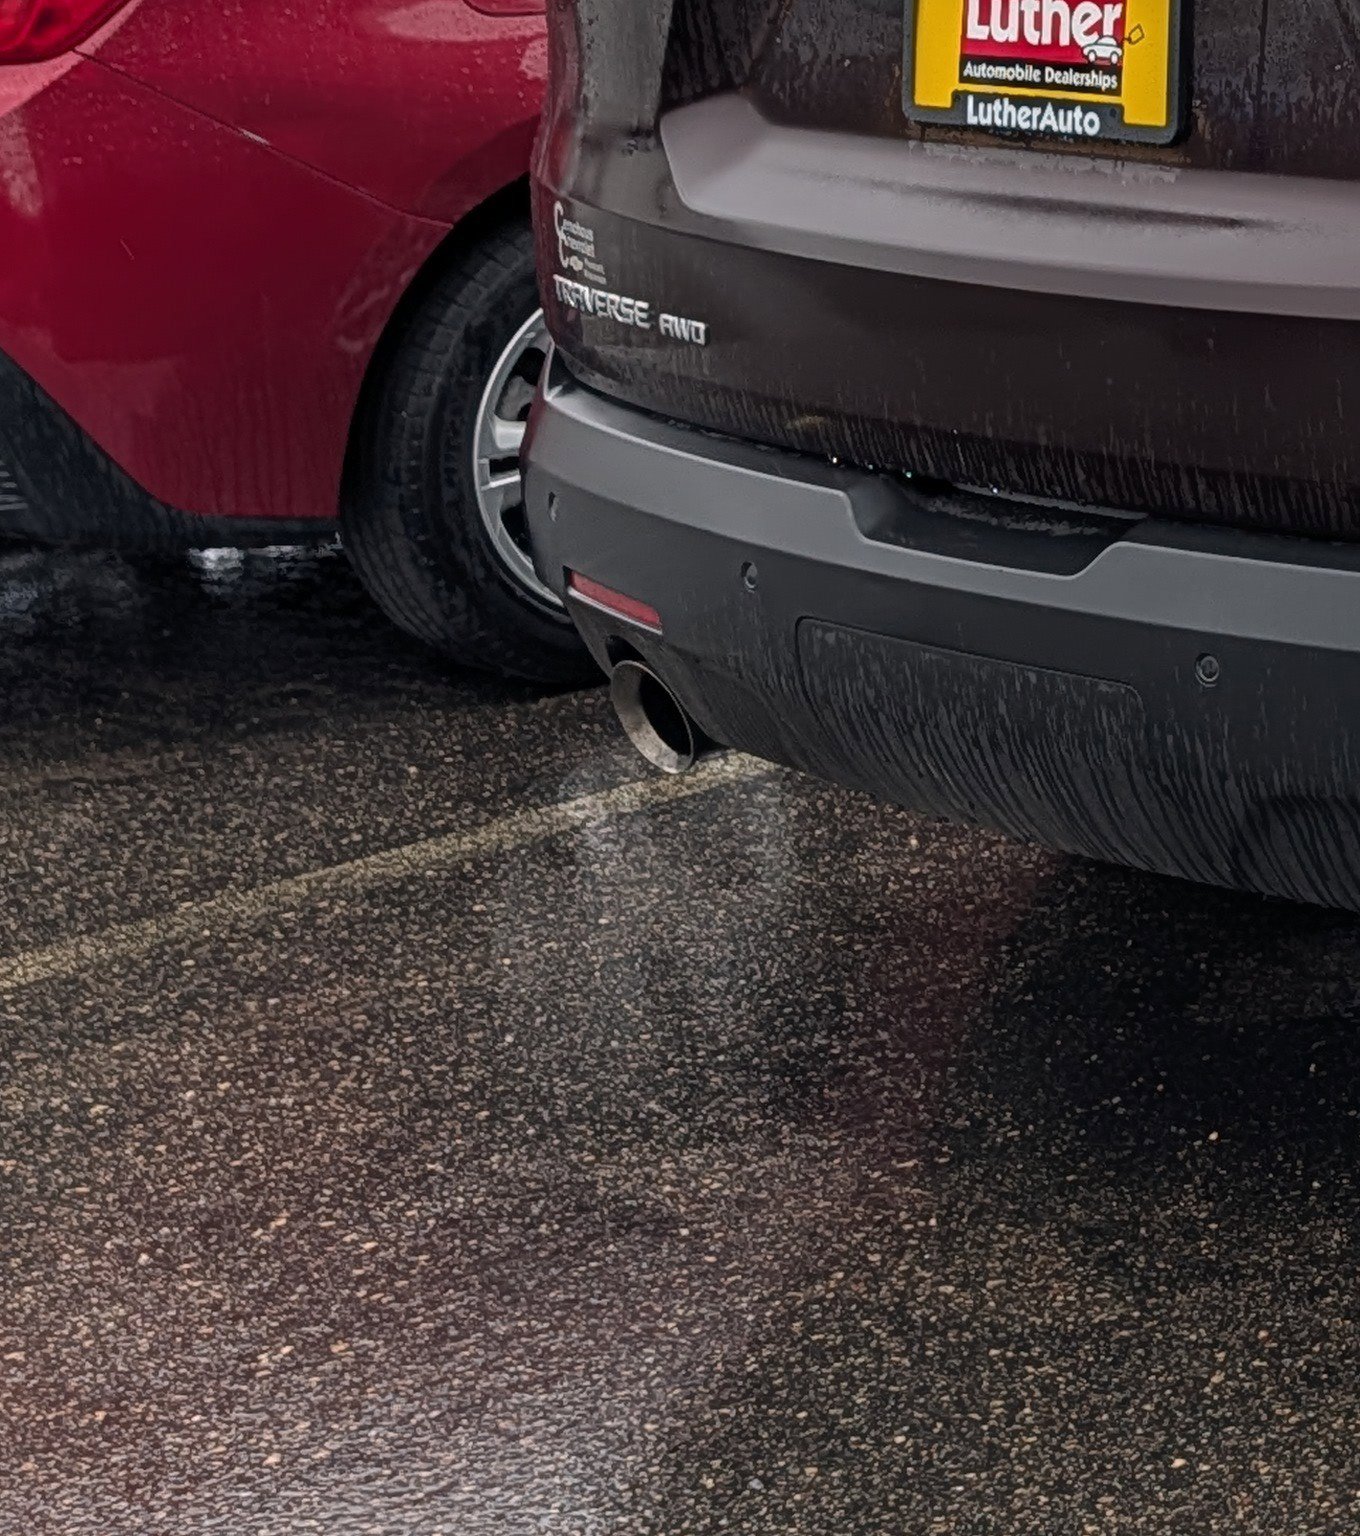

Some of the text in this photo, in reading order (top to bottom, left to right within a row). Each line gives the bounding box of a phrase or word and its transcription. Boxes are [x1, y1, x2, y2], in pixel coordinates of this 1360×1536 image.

[963, 62, 1118, 91] Automobile Dealerships
[966, 95, 1101, 136] LutherAuto
[553, 274, 706, 346] TRAVERSE AWD
